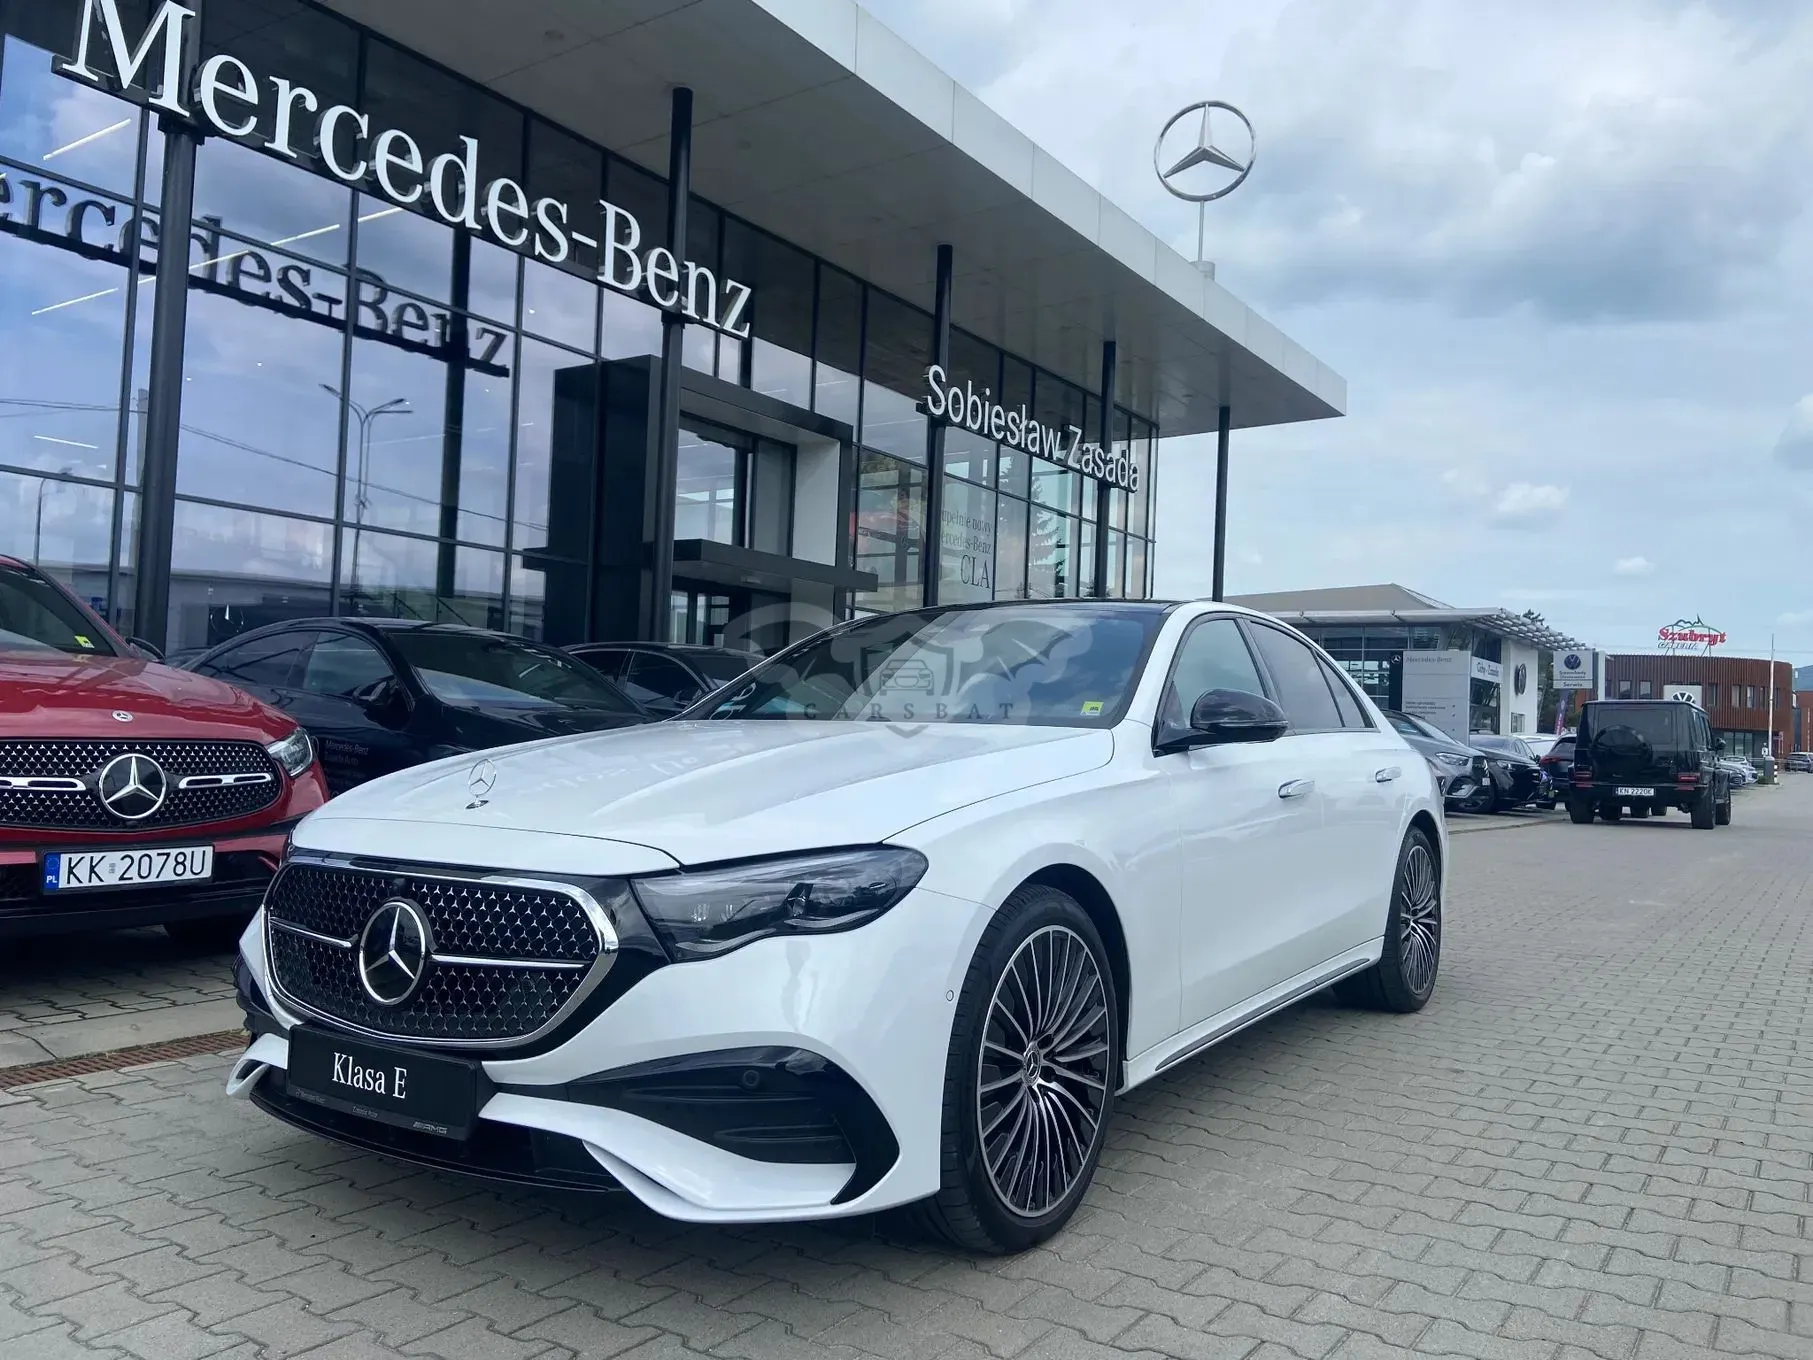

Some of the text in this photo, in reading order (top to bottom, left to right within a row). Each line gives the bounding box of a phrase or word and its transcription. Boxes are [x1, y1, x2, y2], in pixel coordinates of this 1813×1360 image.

[58, 0, 752, 339] Mercedes-Benz
[927, 364, 1139, 492] Sobiesław Zasada
[961, 555, 990, 589] CLA
[1658, 628, 1727, 646] Szubryt
[46, 875, 58, 885] PL
[66, 849, 207, 885] KK 2078U
[332, 1052, 408, 1099] Klasa E
